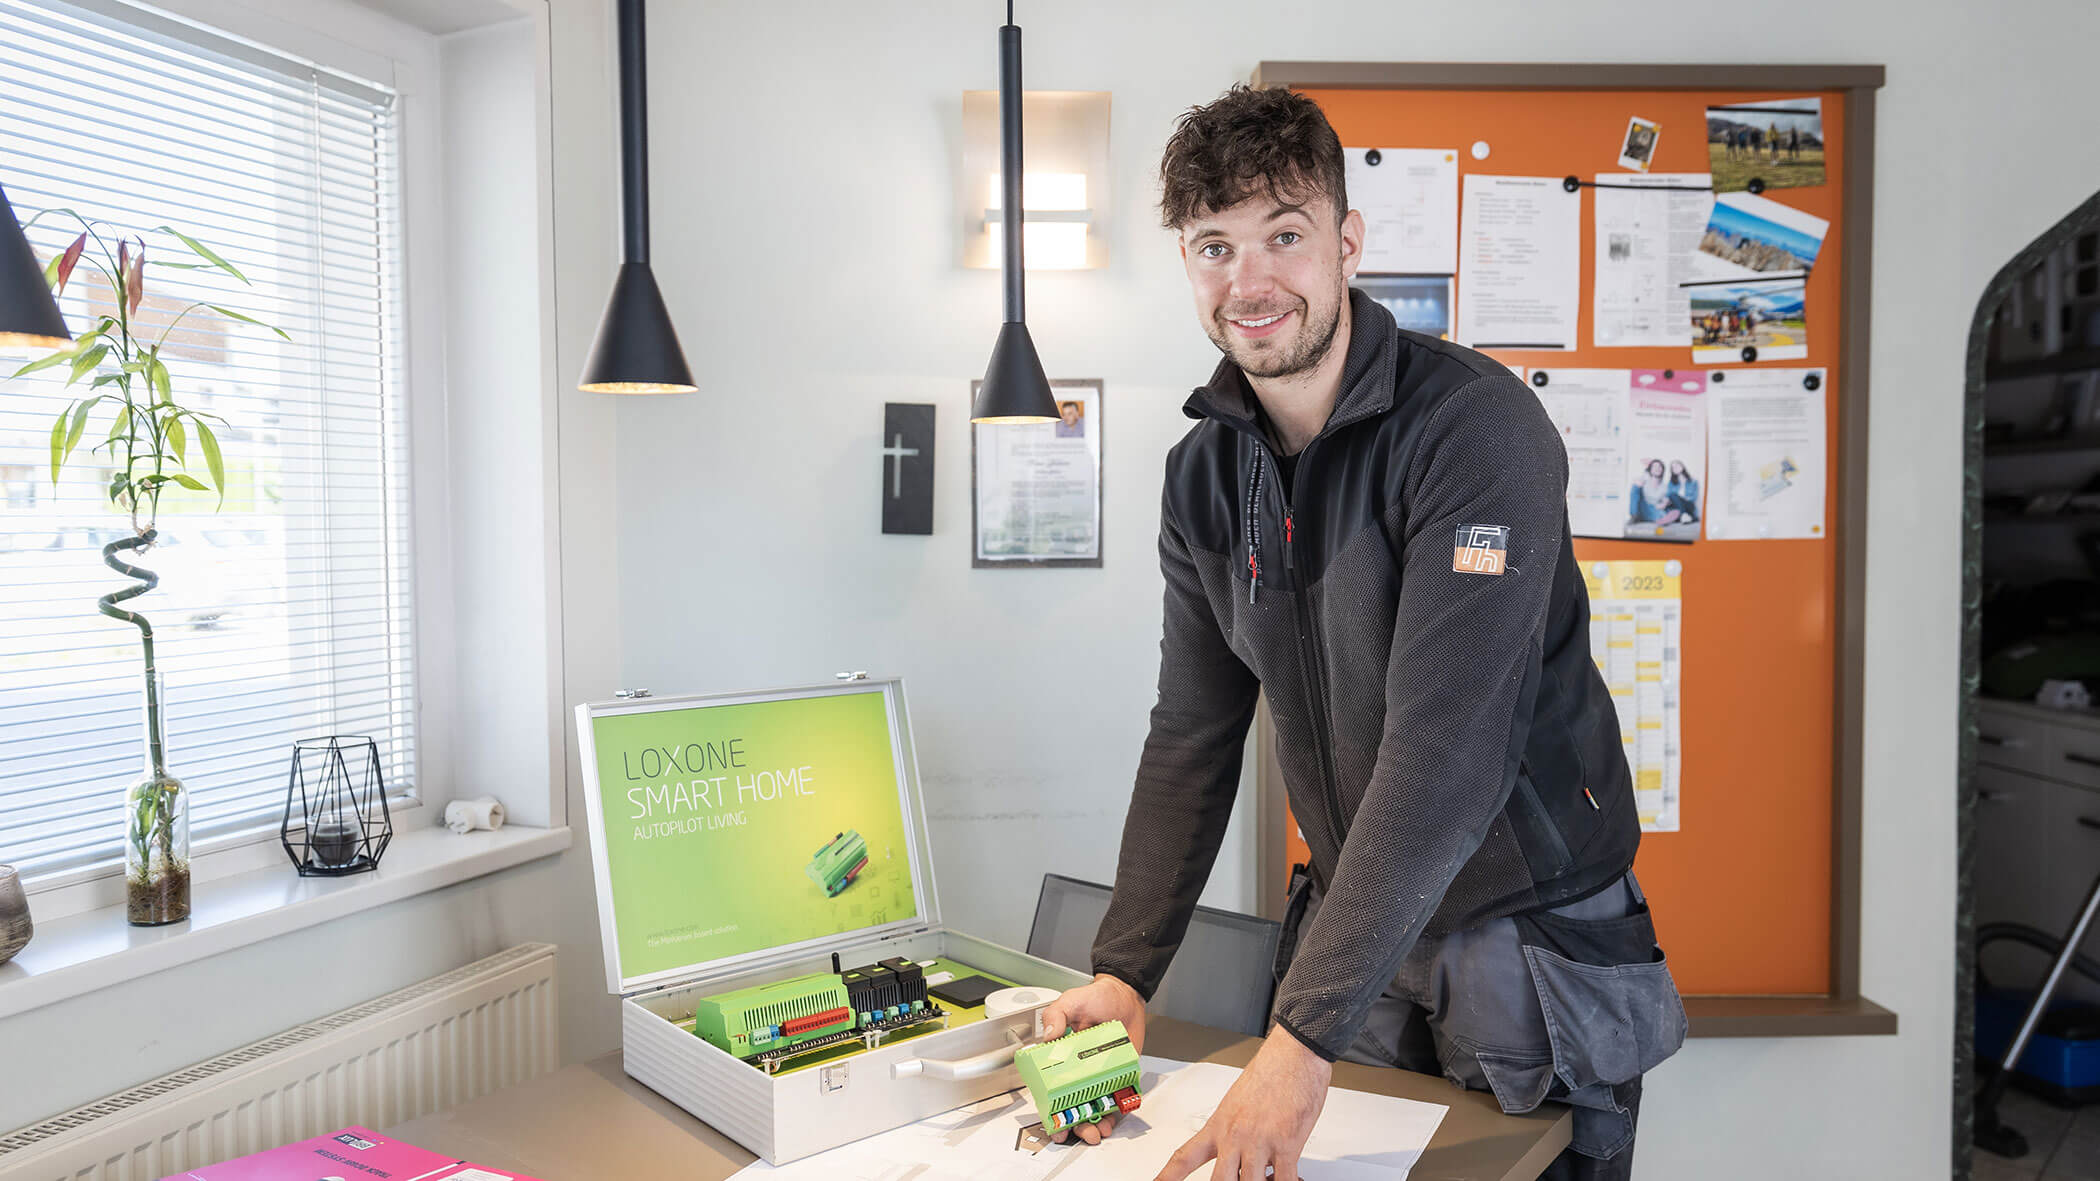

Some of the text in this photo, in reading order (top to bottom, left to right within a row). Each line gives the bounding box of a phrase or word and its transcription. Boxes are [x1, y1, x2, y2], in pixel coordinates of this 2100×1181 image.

[1622, 575, 1665, 591] 2023
[623, 738, 746, 781] LOXONE
[627, 765, 816, 819] SMART HOME
[633, 810, 747, 840] AUTOPILOT LIVING
